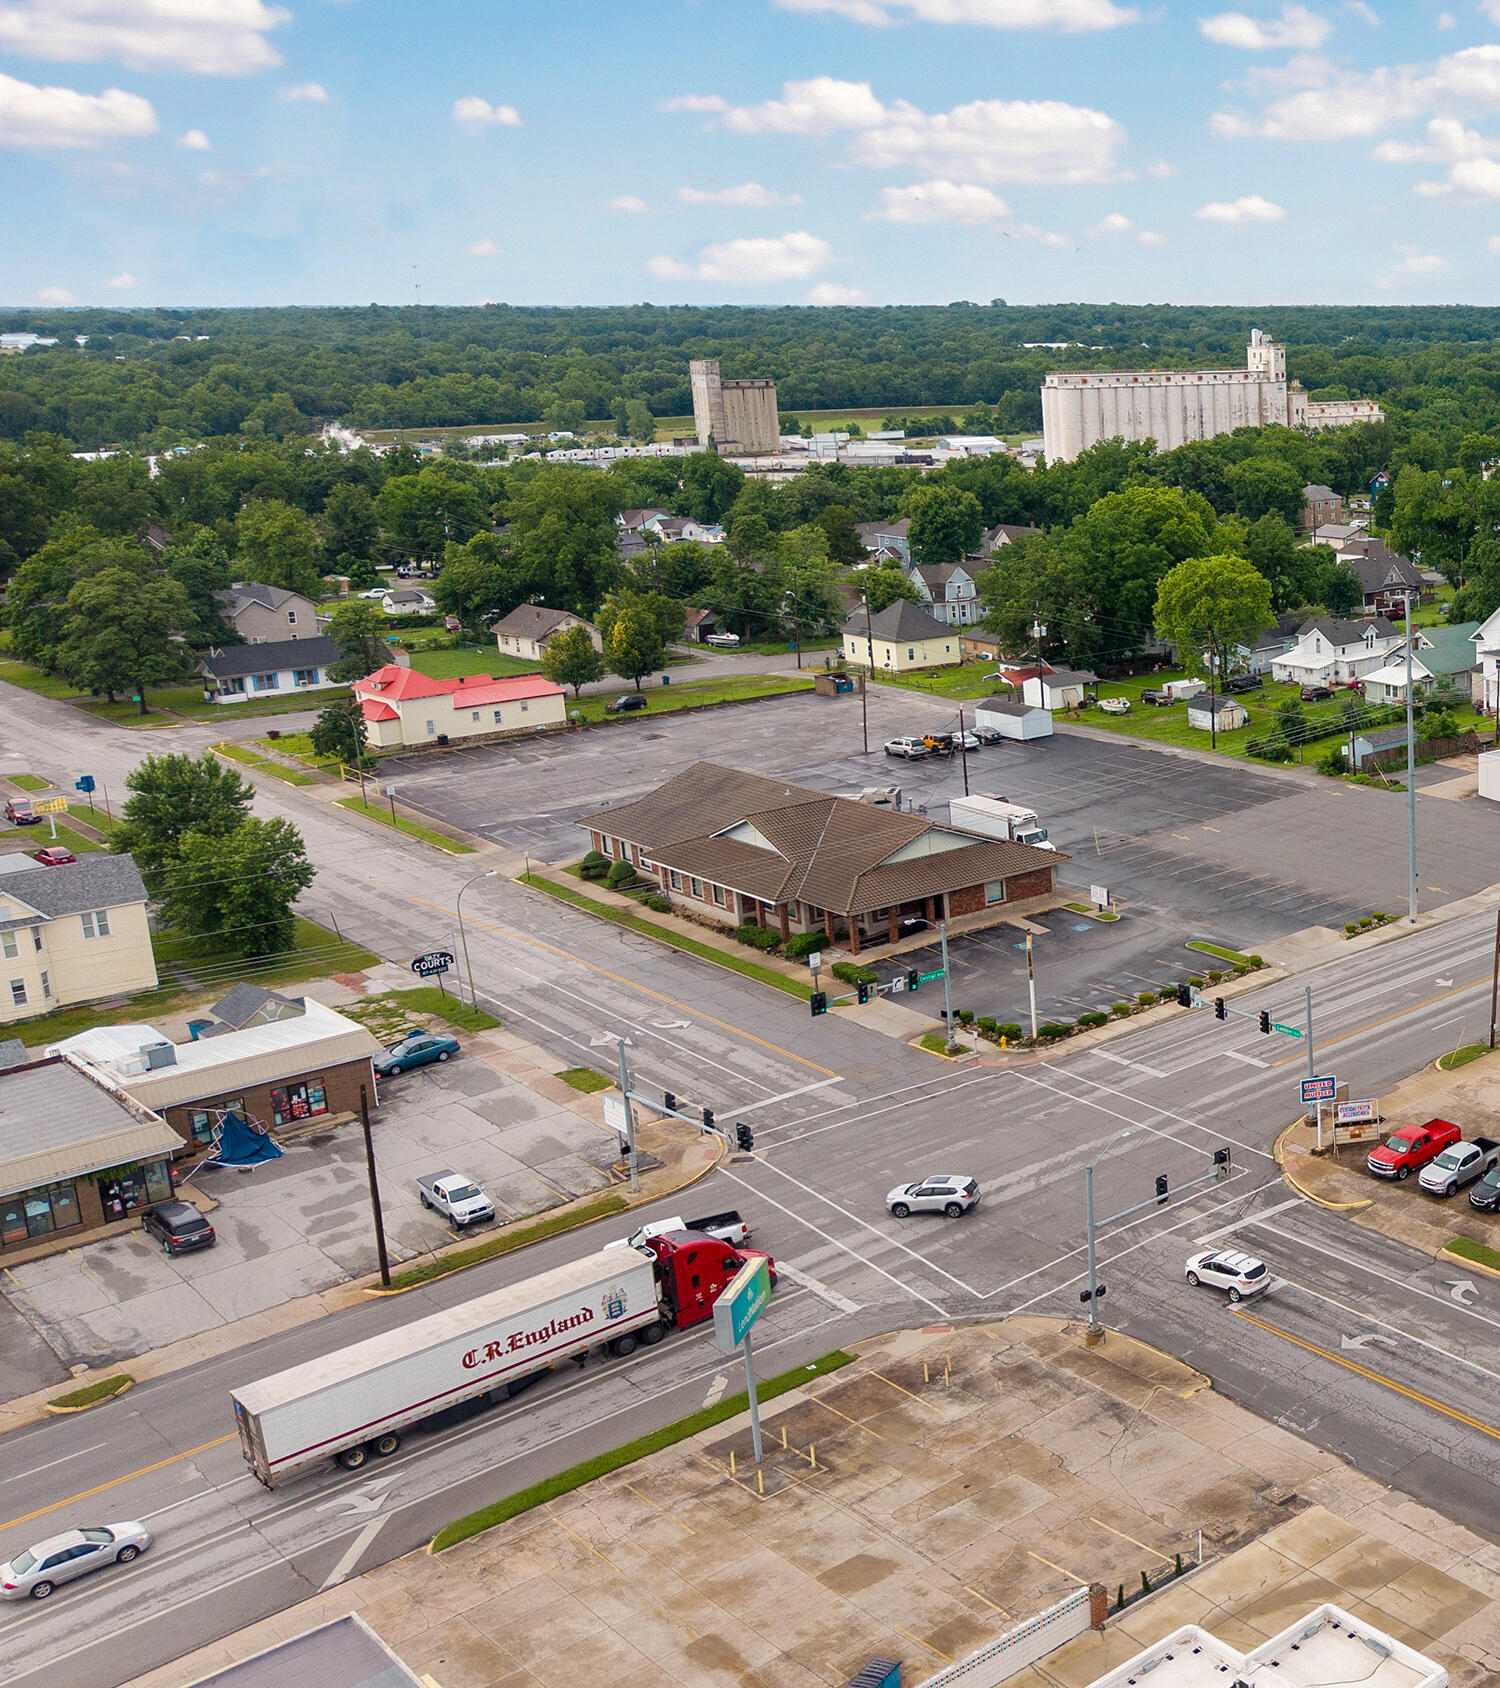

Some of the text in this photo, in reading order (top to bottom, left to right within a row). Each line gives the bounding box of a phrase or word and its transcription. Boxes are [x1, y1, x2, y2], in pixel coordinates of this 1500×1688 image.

[413, 955, 452, 971] COURTS
[1304, 1080, 1333, 1090] UNITED
[1304, 1089, 1333, 1099] MUFFLER
